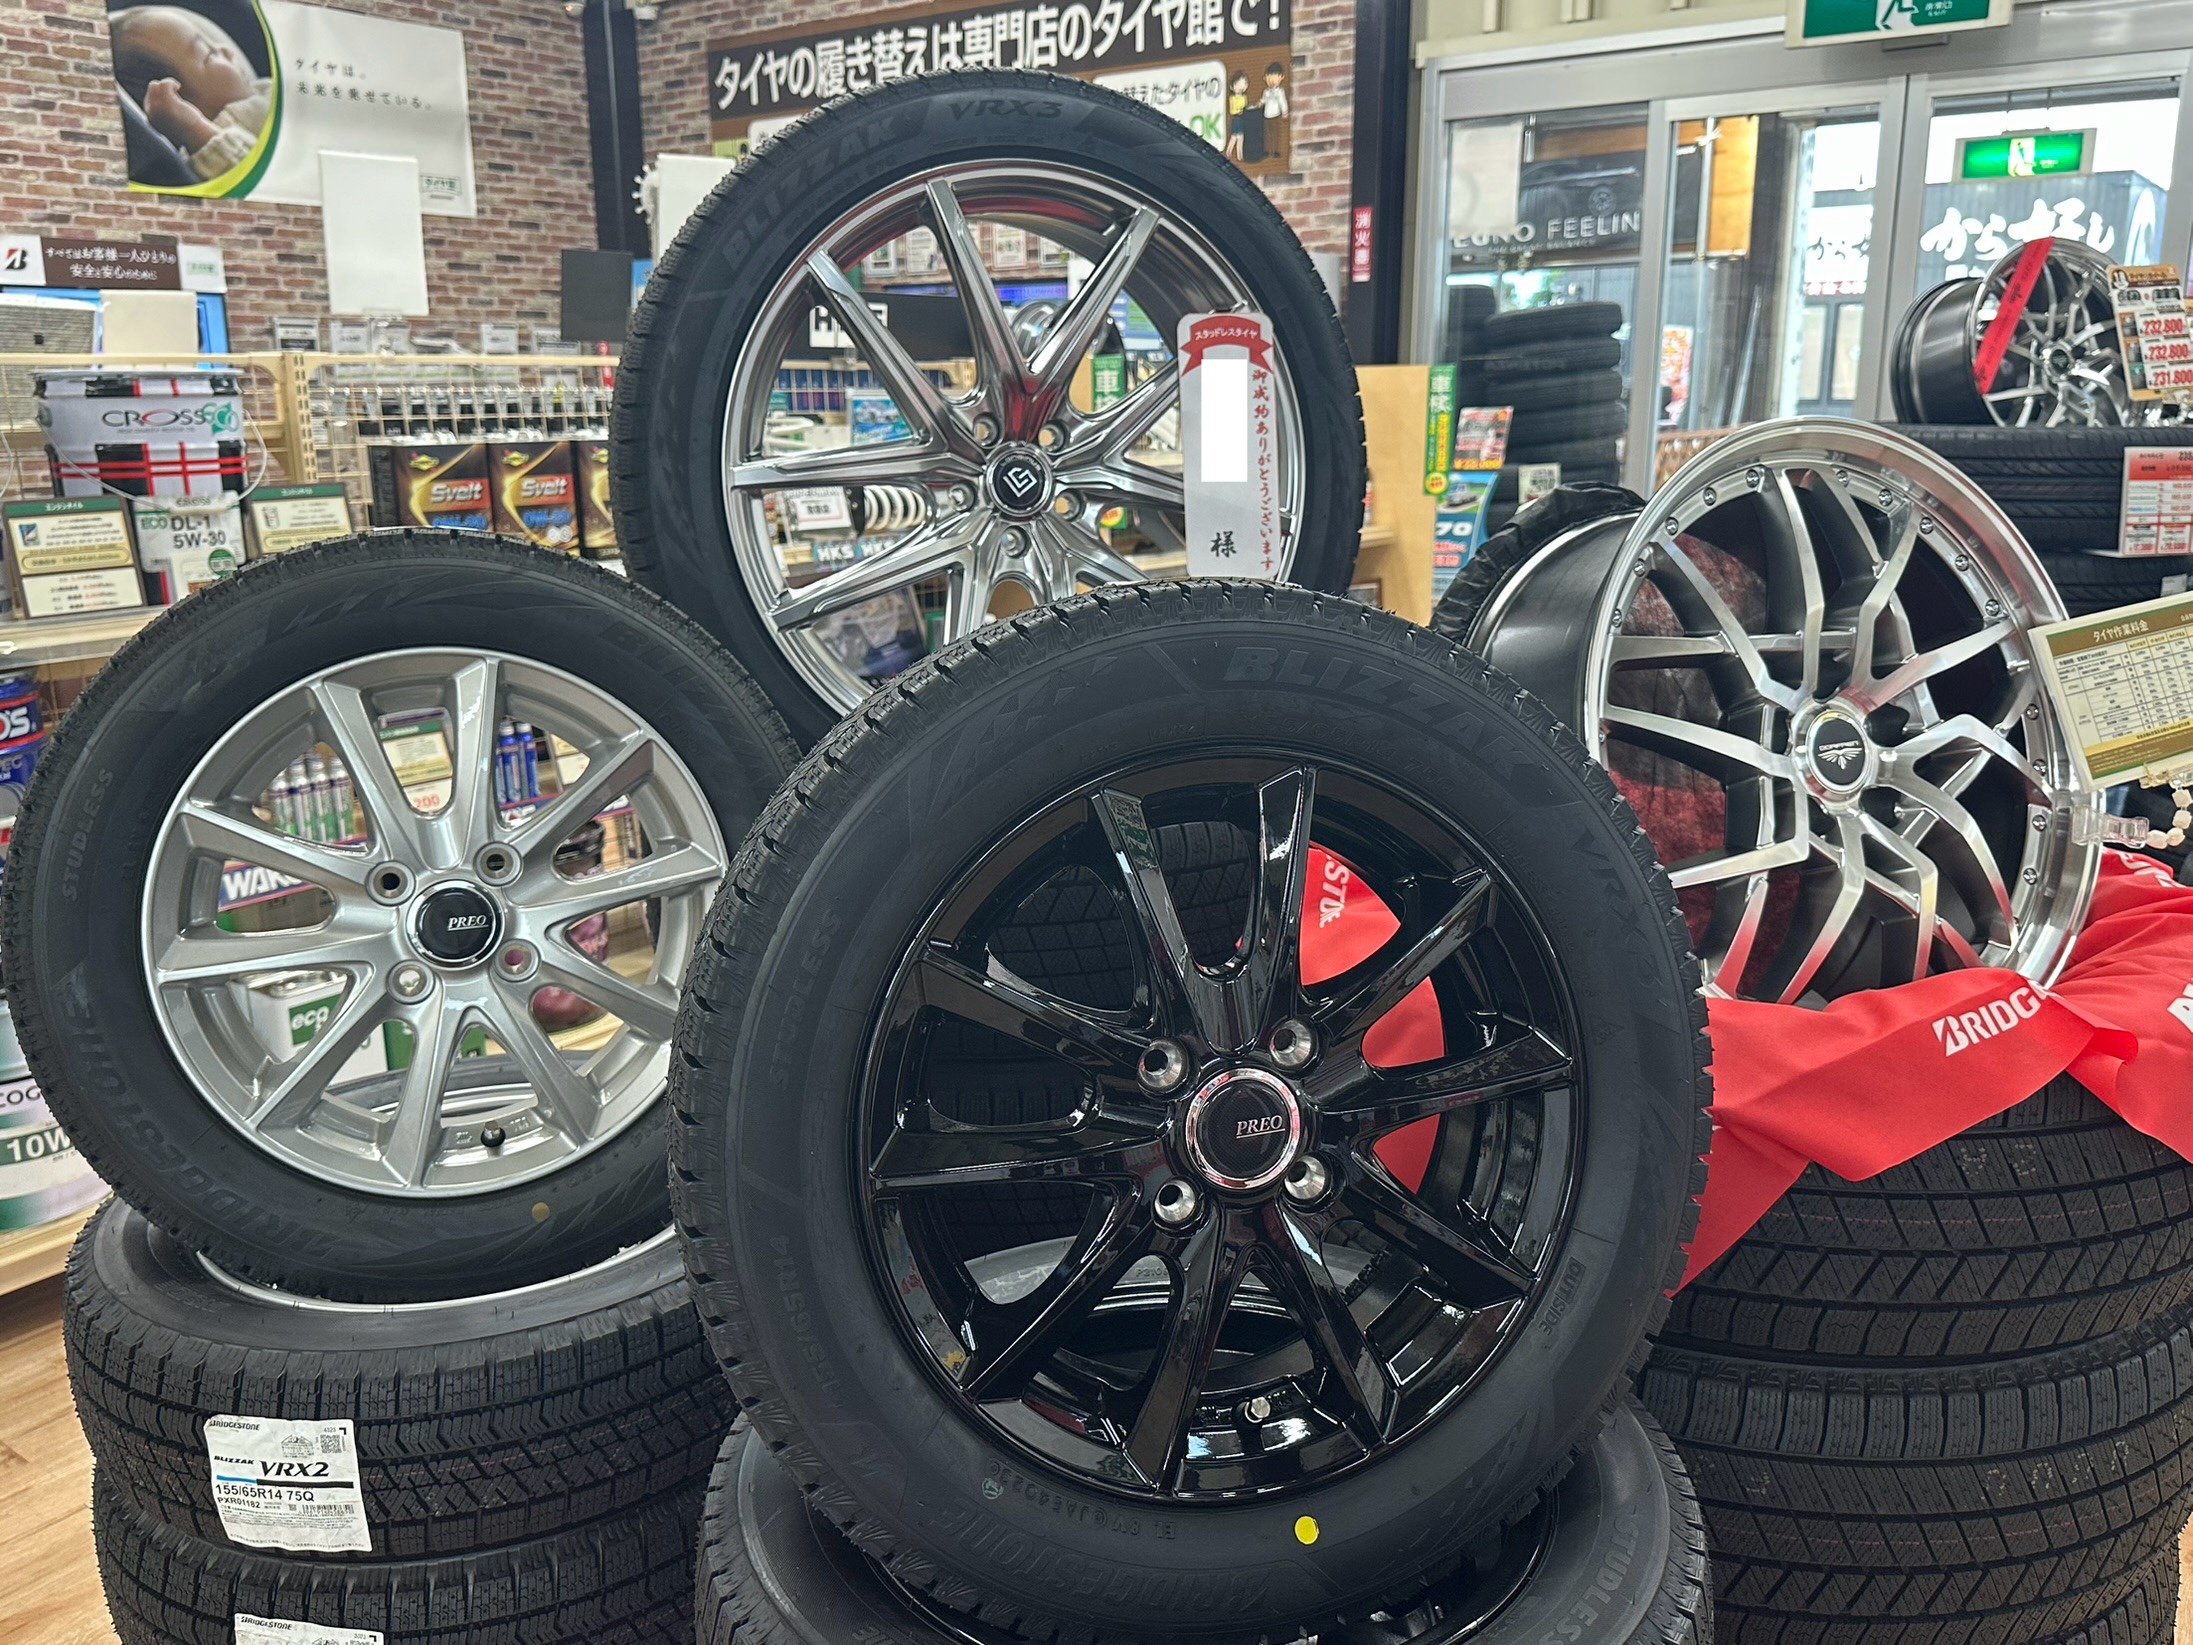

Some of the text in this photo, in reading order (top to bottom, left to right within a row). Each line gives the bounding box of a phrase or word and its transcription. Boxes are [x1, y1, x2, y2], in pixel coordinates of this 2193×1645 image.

[1547, 211, 1641, 240] FEELIN
[1194, 327, 1259, 341] スタッドレスタイヤ
[1252, 368, 1274, 572] 御成約ありがとうございます
[173, 532, 227, 549] 5W-30
[1210, 530, 1237, 558] 様
[1223, 647, 1539, 781] BLIZZAK
[448, 914, 487, 929] PREO
[1932, 979, 2051, 1057] BRIDG
[1236, 1115, 1283, 1136] PREO
[214, 1455, 330, 1478] BLIZZAK VRX2
[215, 1483, 315, 1503] 155/65R14 75Q
[217, 1496, 261, 1509] PXR01182
